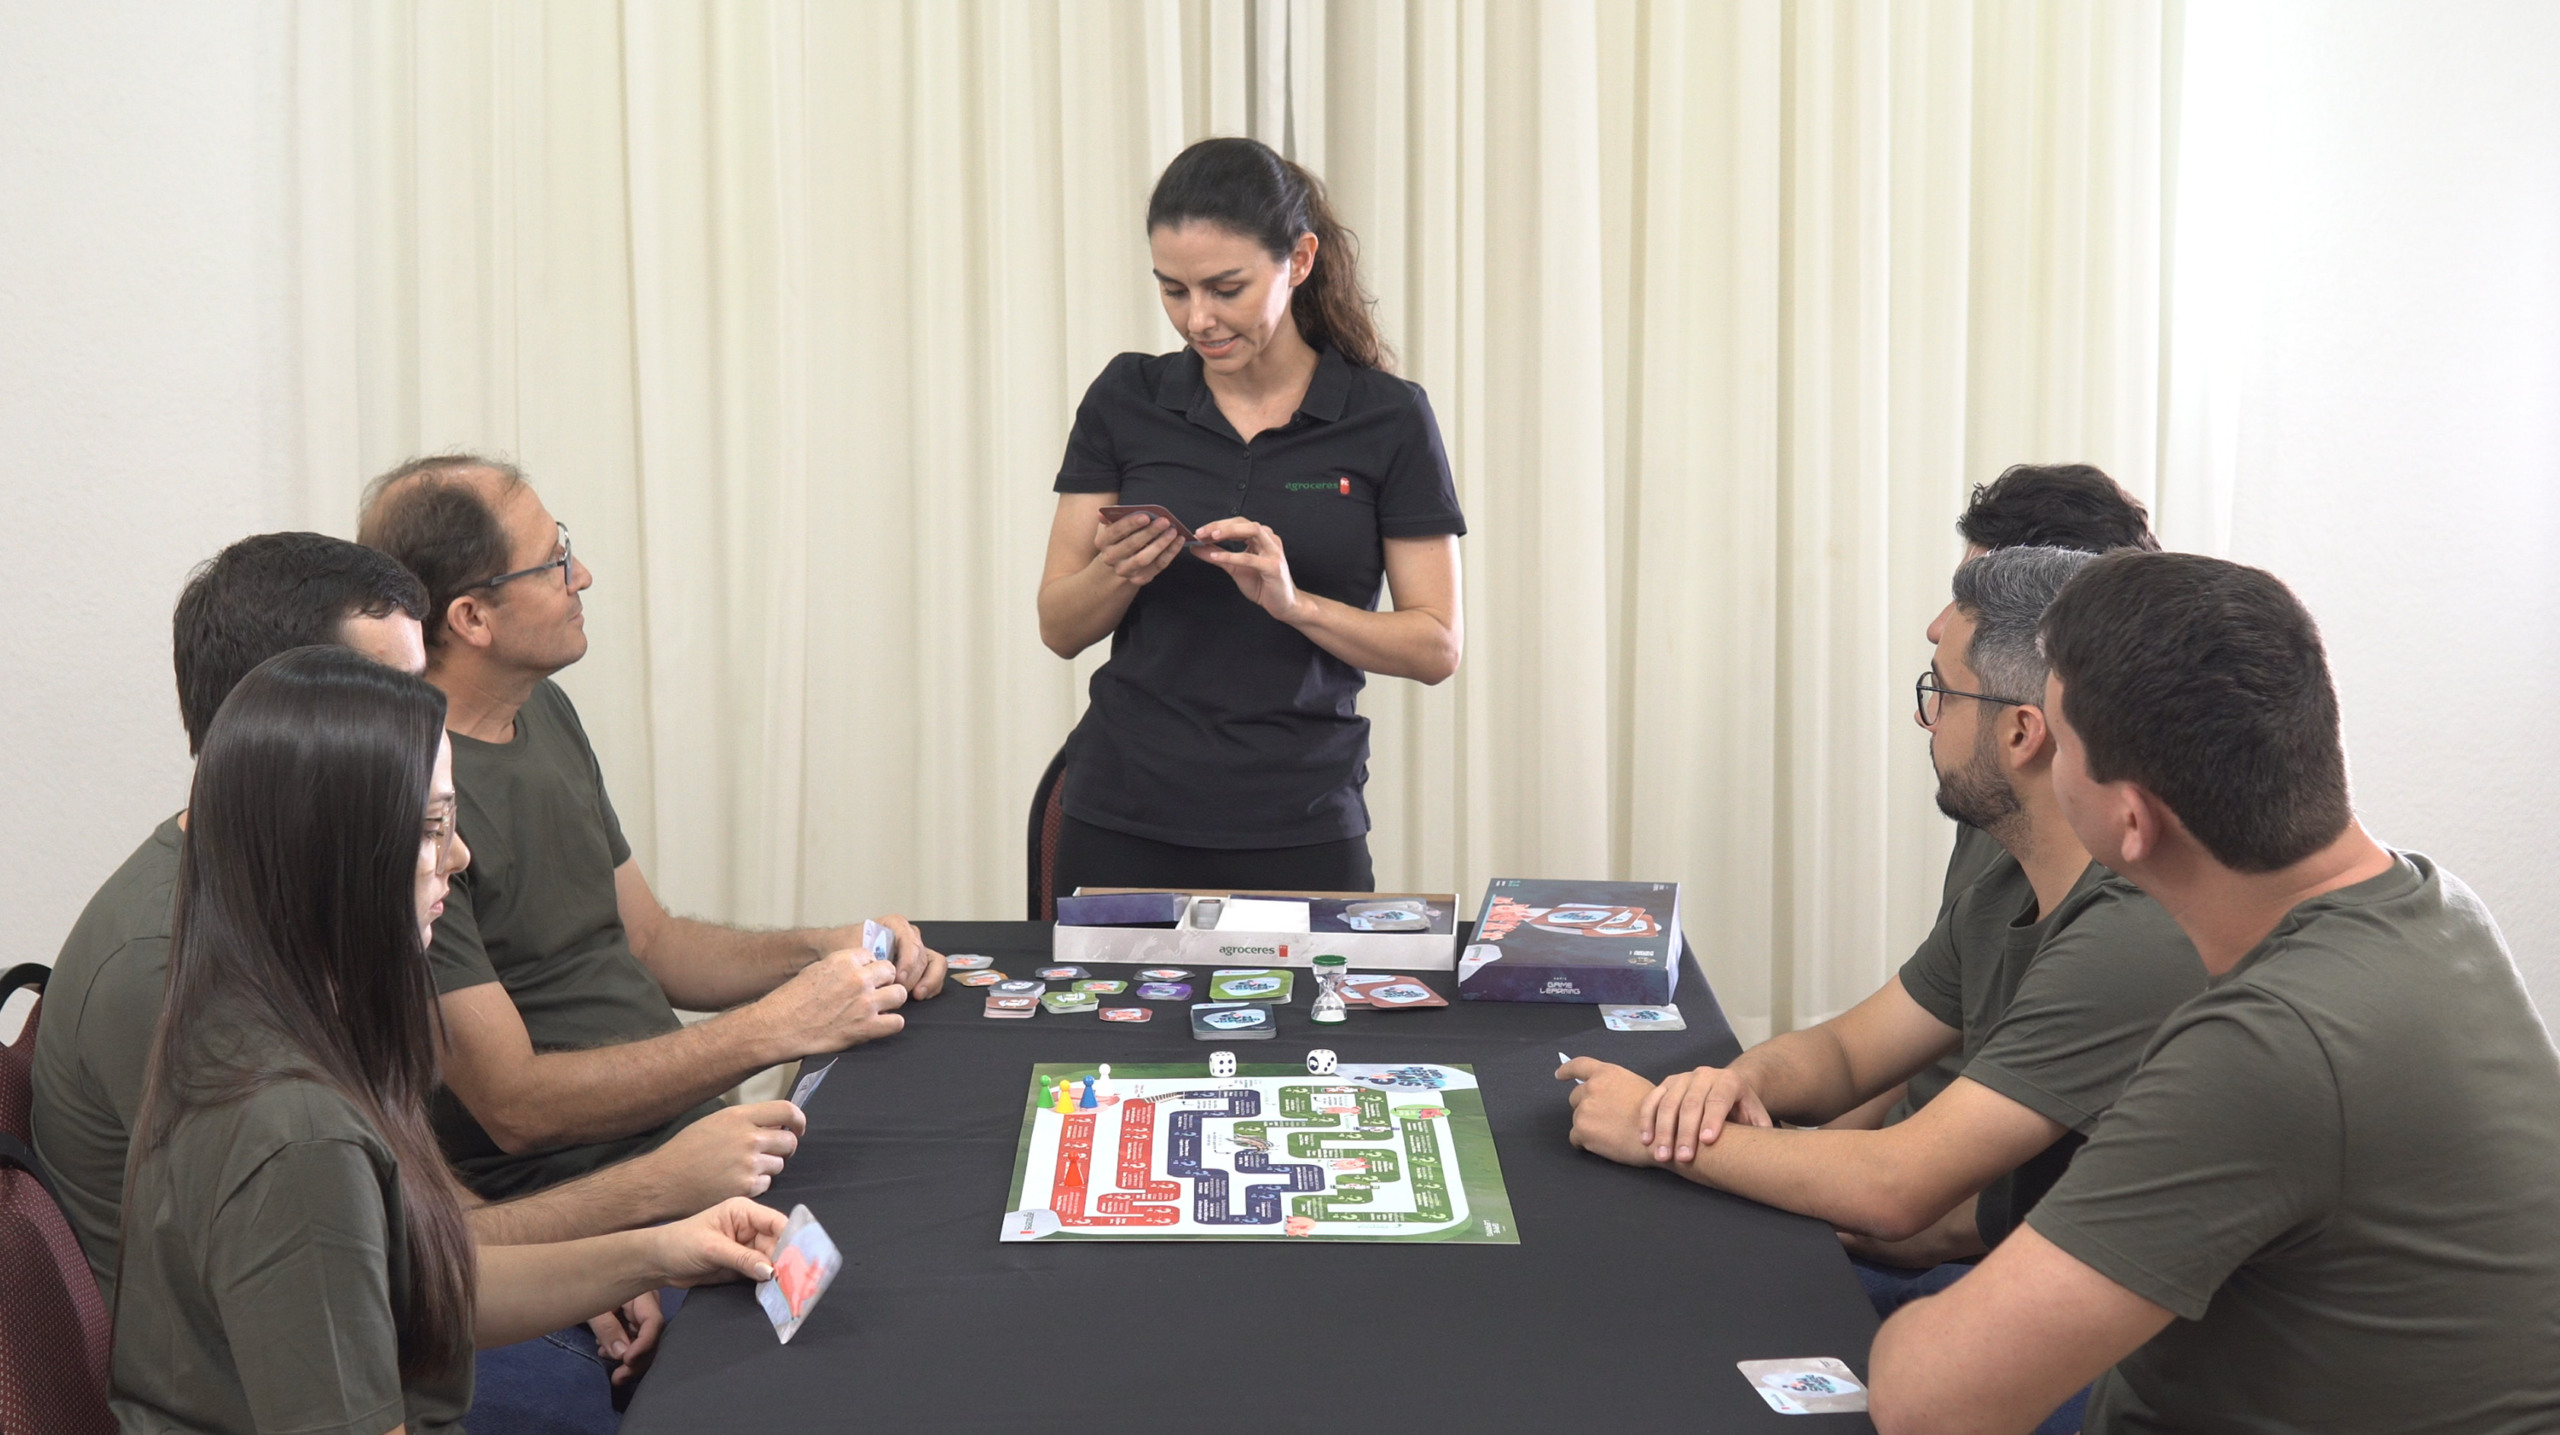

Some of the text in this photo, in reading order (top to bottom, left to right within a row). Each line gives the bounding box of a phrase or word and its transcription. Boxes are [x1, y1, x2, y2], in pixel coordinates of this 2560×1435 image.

[1285, 482, 1339, 492] agroceres
[1219, 945, 1275, 956] agroceres
[1547, 981, 1573, 989] GAME
[1539, 987, 1581, 995] LEARNING
